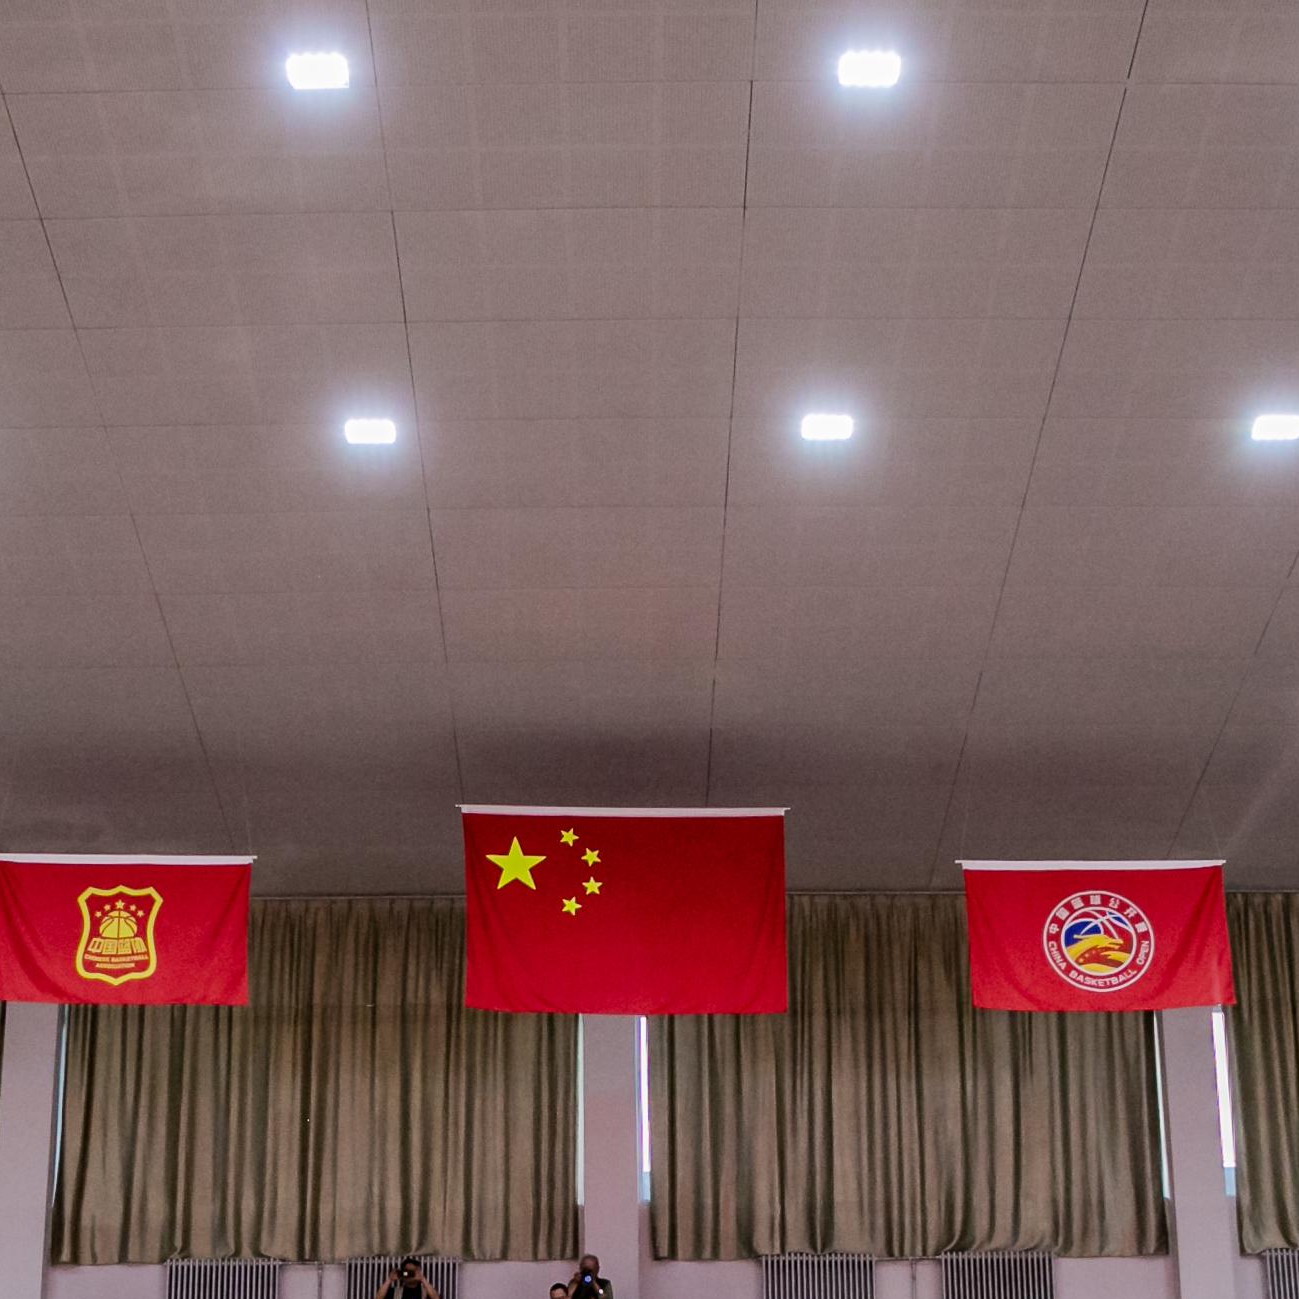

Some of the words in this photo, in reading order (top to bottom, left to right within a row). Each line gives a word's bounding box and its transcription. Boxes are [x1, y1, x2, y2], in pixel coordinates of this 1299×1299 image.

[1048, 941, 1067, 970] CHINA
[1068, 969, 1138, 987] BASKETBALL
[1136, 940, 1149, 965] OPEN
